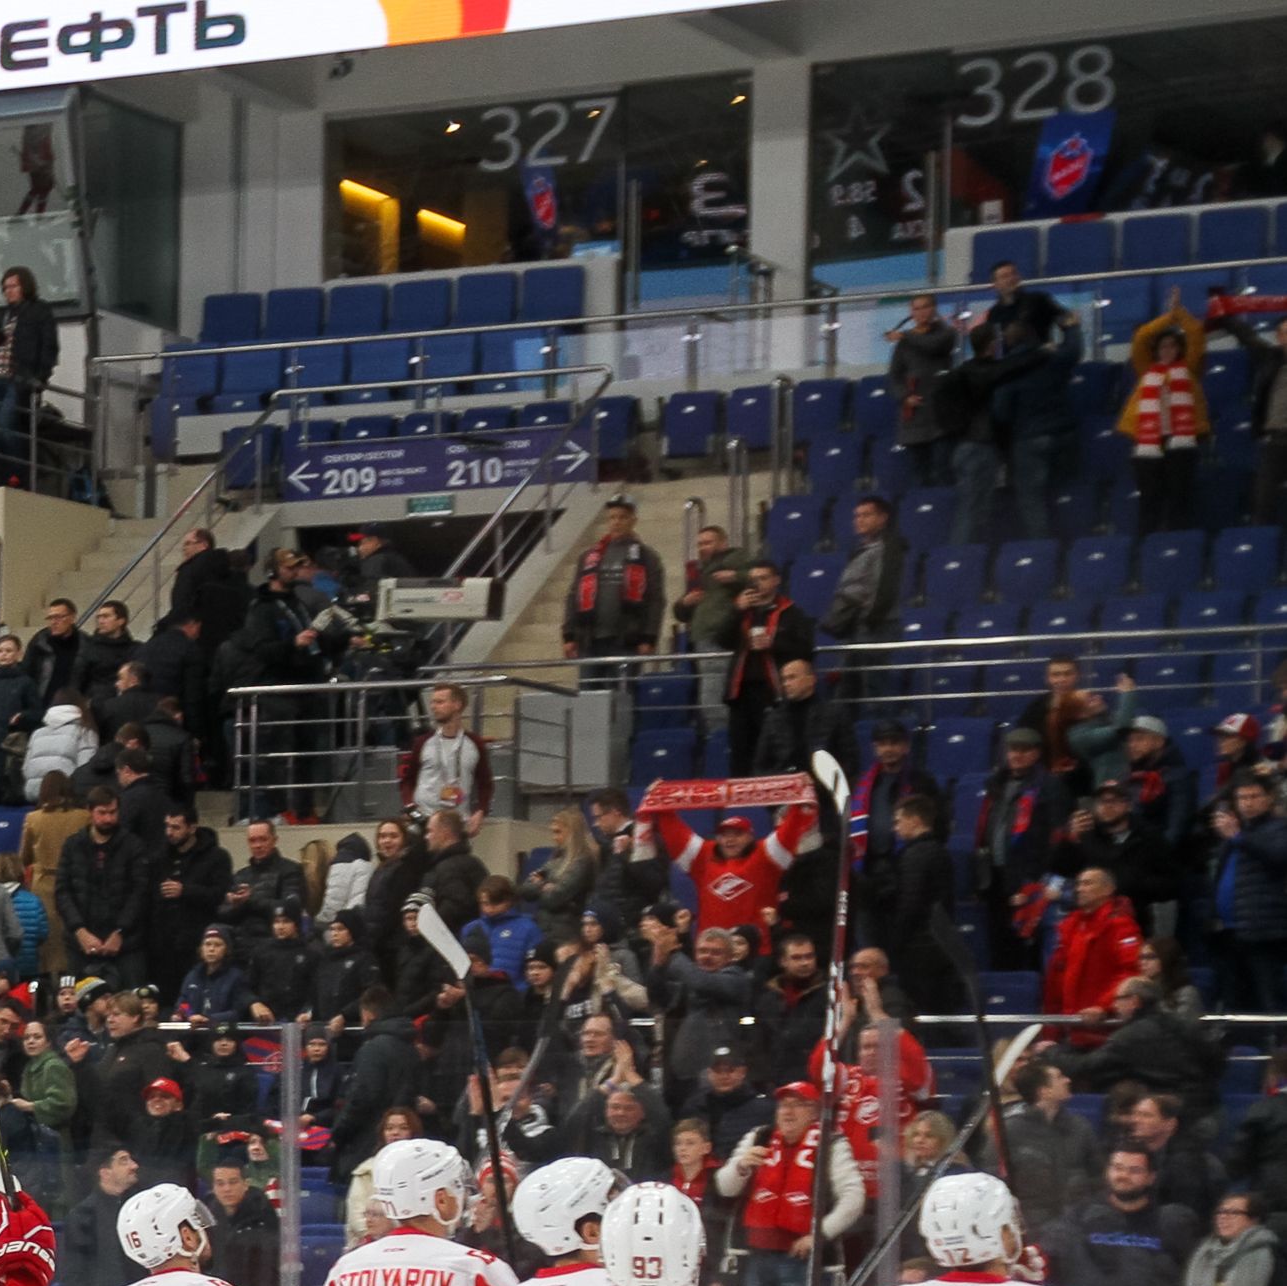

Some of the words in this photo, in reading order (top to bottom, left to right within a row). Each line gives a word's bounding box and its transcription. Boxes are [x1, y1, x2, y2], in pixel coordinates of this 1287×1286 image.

[956, 45, 1117, 128] 328
[478, 98, 618, 173] 327
[323, 466, 377, 496] 209
[446, 457, 504, 487] 210
[125, 1230, 143, 1249] 16
[632, 1255, 665, 1280] 93
